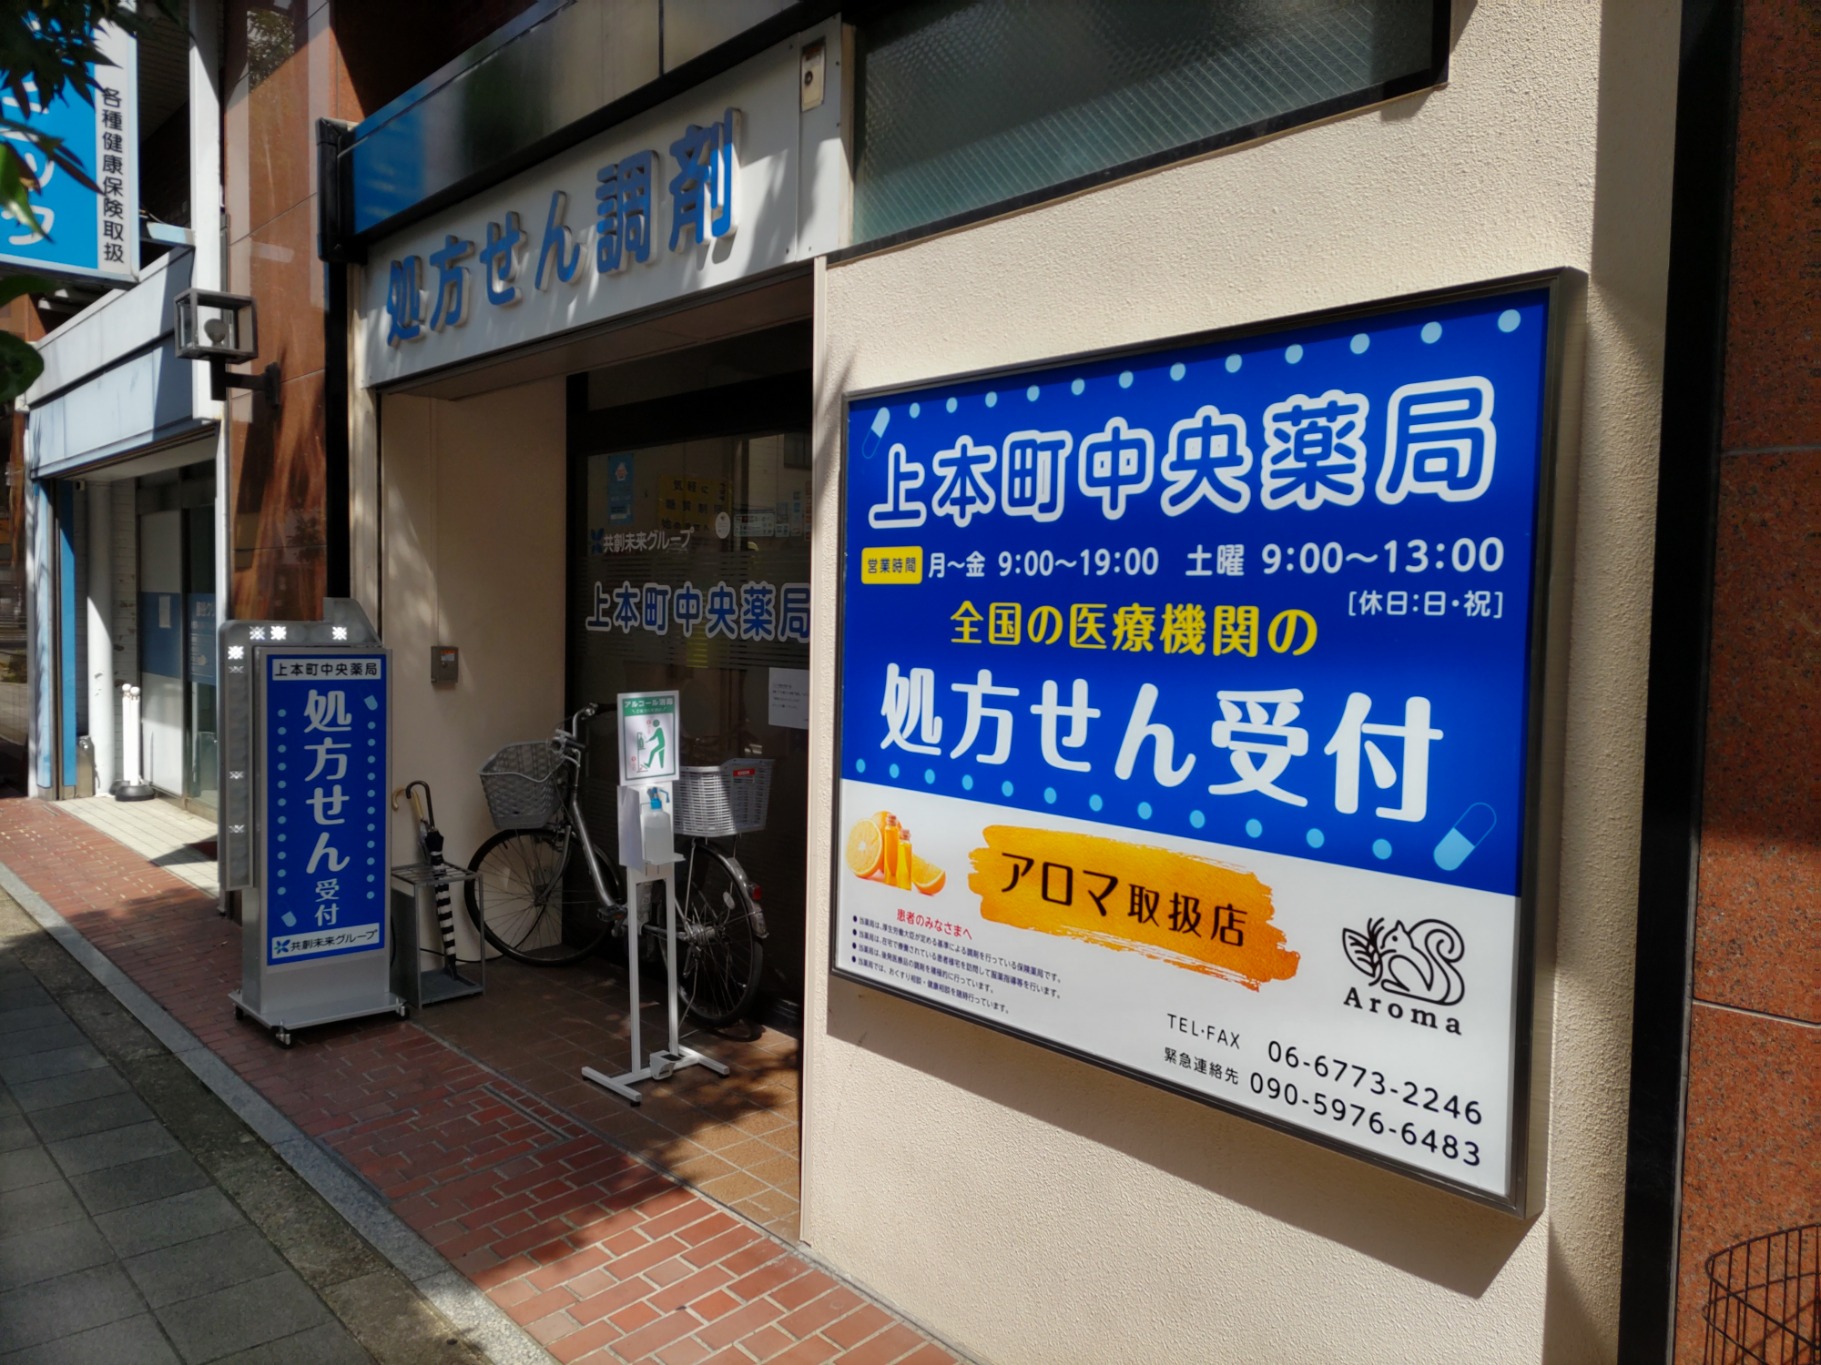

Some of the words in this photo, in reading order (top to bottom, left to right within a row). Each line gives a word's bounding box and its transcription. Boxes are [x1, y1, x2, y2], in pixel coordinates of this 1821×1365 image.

[101, 87, 125, 265] 各種健康保険取扱
[387, 106, 742, 347] 処方せん調剤
[868, 375, 1498, 528] 上本町中央薬局
[603, 527, 695, 553] 共創未来グループ
[866, 556, 917, 576] 営業時間
[1185, 543, 1246, 578] 土曜
[586, 581, 811, 643] 上本町中央薬局
[949, 600, 1318, 659] 全国の医療機関の
[274, 662, 378, 680] 上本町中央薬局
[880, 662, 1444, 824] 処方せん受付
[303, 688, 353, 928] 処方せん受付
[896, 908, 973, 940] 患者のみなさまへ
[1001, 852, 1248, 947] アロマ取扱店
[290, 928, 378, 955] 共創未来グループ
[1343, 987, 1462, 1035] Aroma
[1164, 1047, 1239, 1085] 緊急連絡先
[1250, 1072, 1481, 1166] 090-5976-6483
[1268, 1041, 1482, 1125] 06-6773-2246
